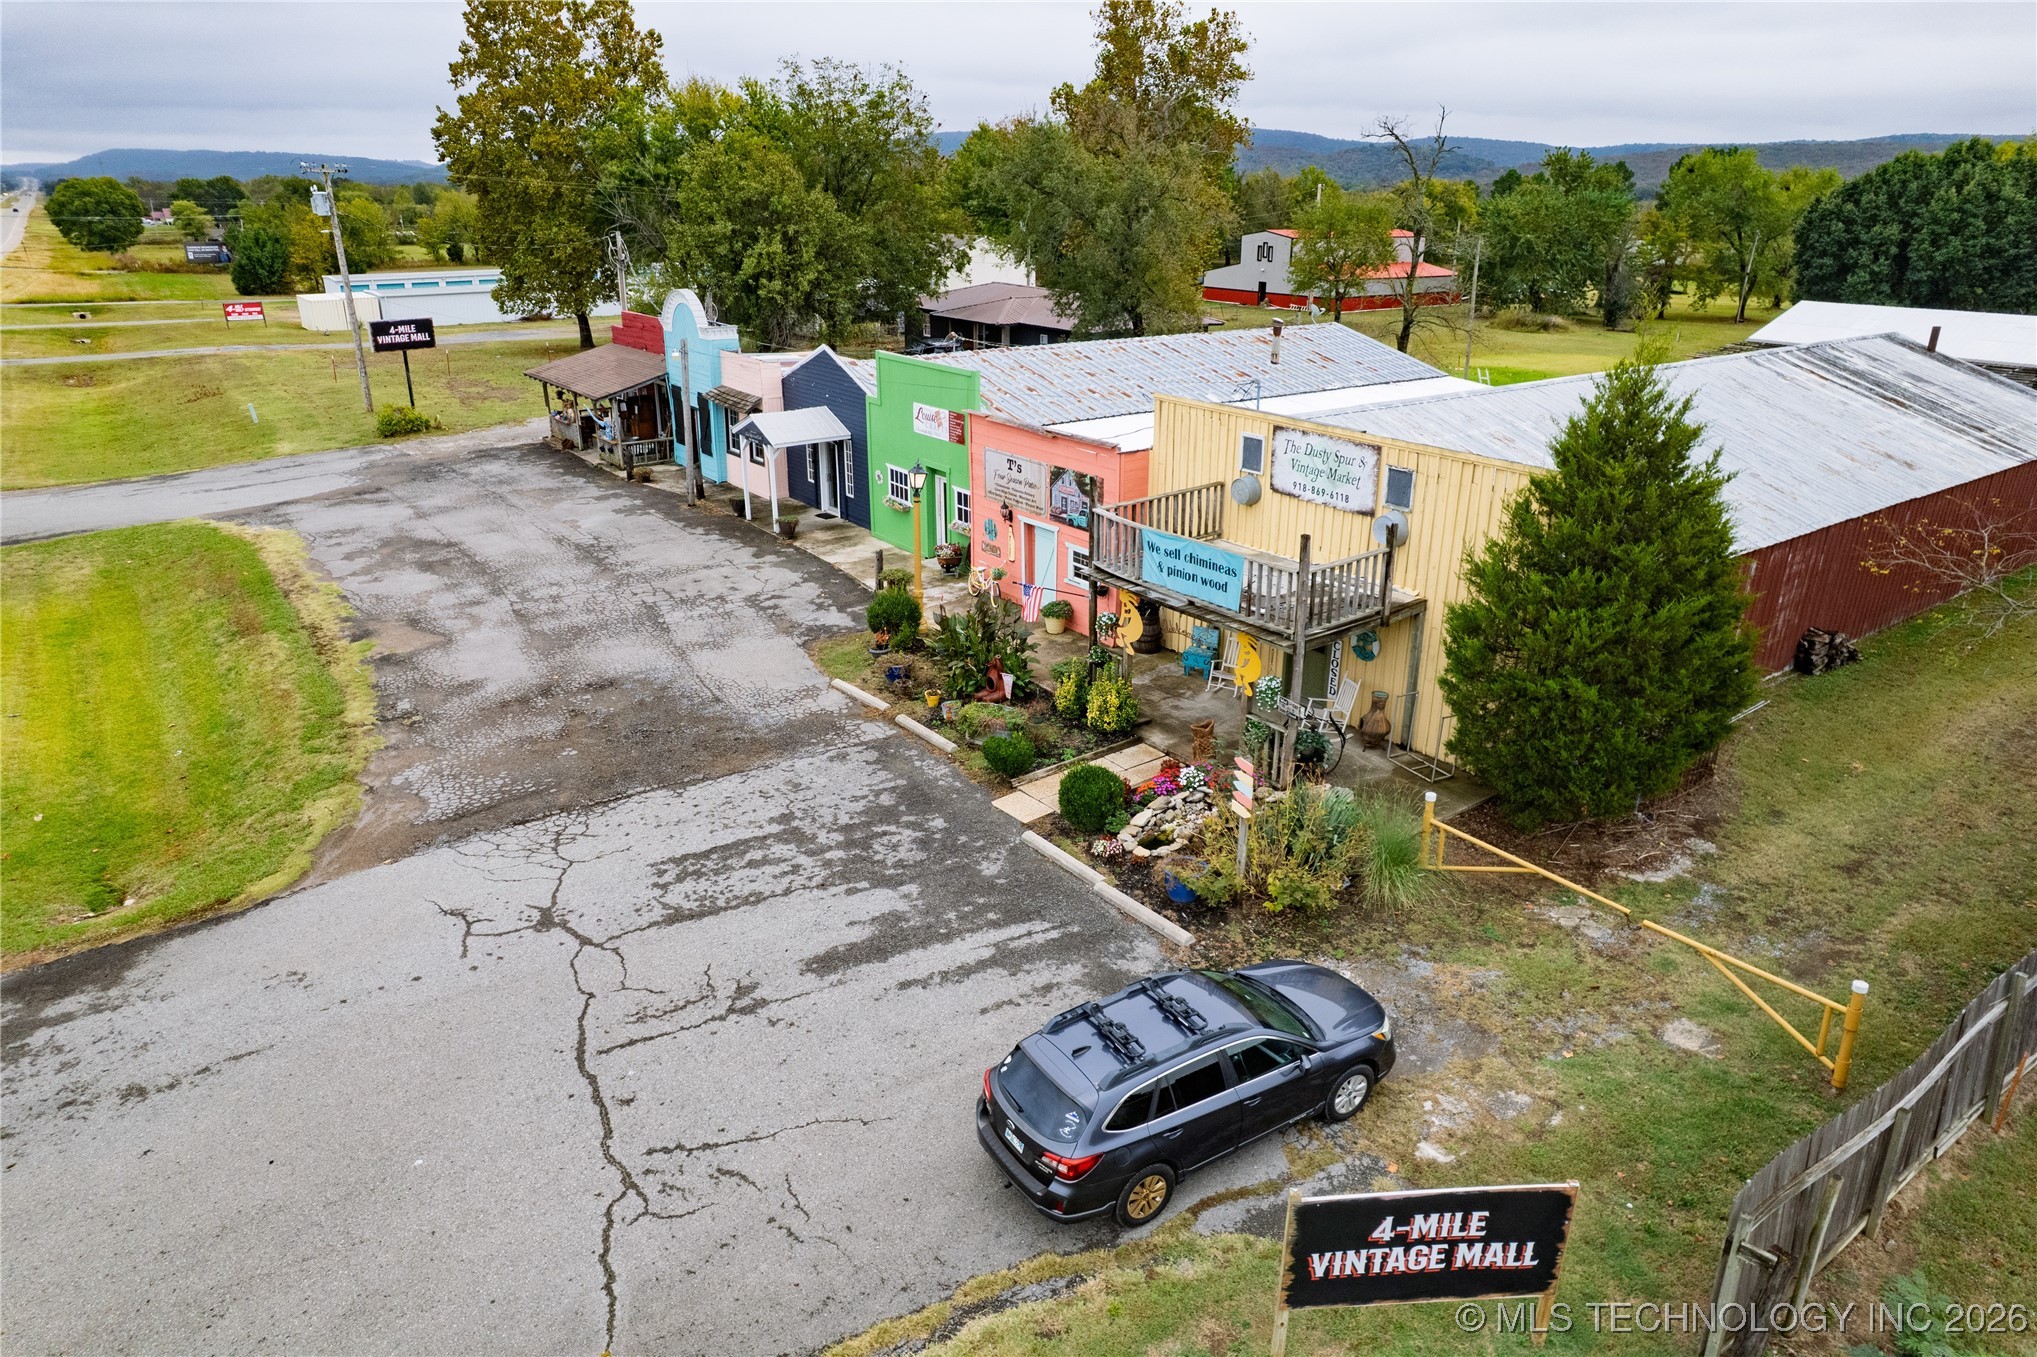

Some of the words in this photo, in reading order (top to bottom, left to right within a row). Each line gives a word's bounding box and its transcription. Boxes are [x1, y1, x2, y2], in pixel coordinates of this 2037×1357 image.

[377, 333, 410, 345] VINTAGE
[411, 332, 431, 342] MALL
[389, 324, 416, 334] 4-MILE
[1007, 458, 1022, 474] T's
[1284, 439, 1302, 455] The
[1304, 442, 1332, 465] Dusty
[1334, 450, 1356, 468] Spur
[1358, 455, 1368, 470] &
[1291, 458, 1326, 483] Vintage
[1327, 467, 1361, 491] Market
[1293, 481, 1350, 504] 918-869-6118
[1147, 540, 1161, 555] We
[1163, 547, 1181, 561] sell
[1184, 552, 1238, 578] chimineas
[1157, 560, 1165, 573] &
[1167, 565, 1198, 583] pinion
[1200, 576, 1228, 593] wood
[1328, 641, 1342, 696] CLOSED
[1369, 1210, 1490, 1243] 4-MILE
[1308, 1243, 1450, 1280] VINTAGE
[1452, 1241, 1540, 1270] MALL
